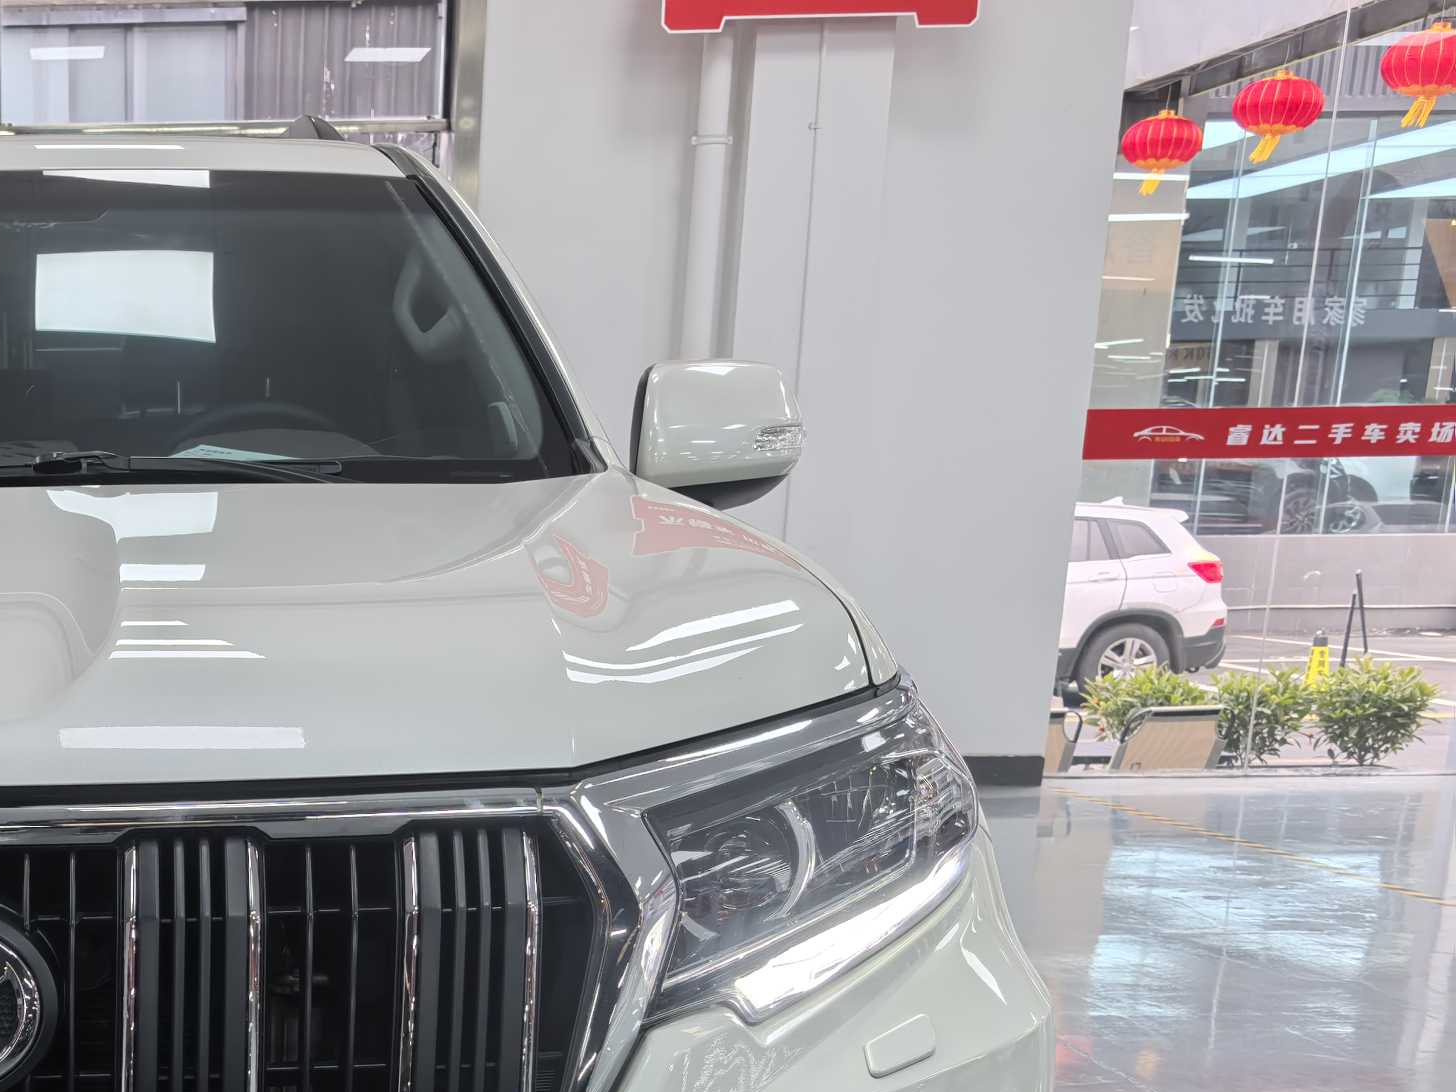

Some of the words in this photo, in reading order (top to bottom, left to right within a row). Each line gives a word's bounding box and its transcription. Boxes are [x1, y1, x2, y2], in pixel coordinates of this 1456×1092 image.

[1226, 422, 1456, 446] 睿达二手车卖场
